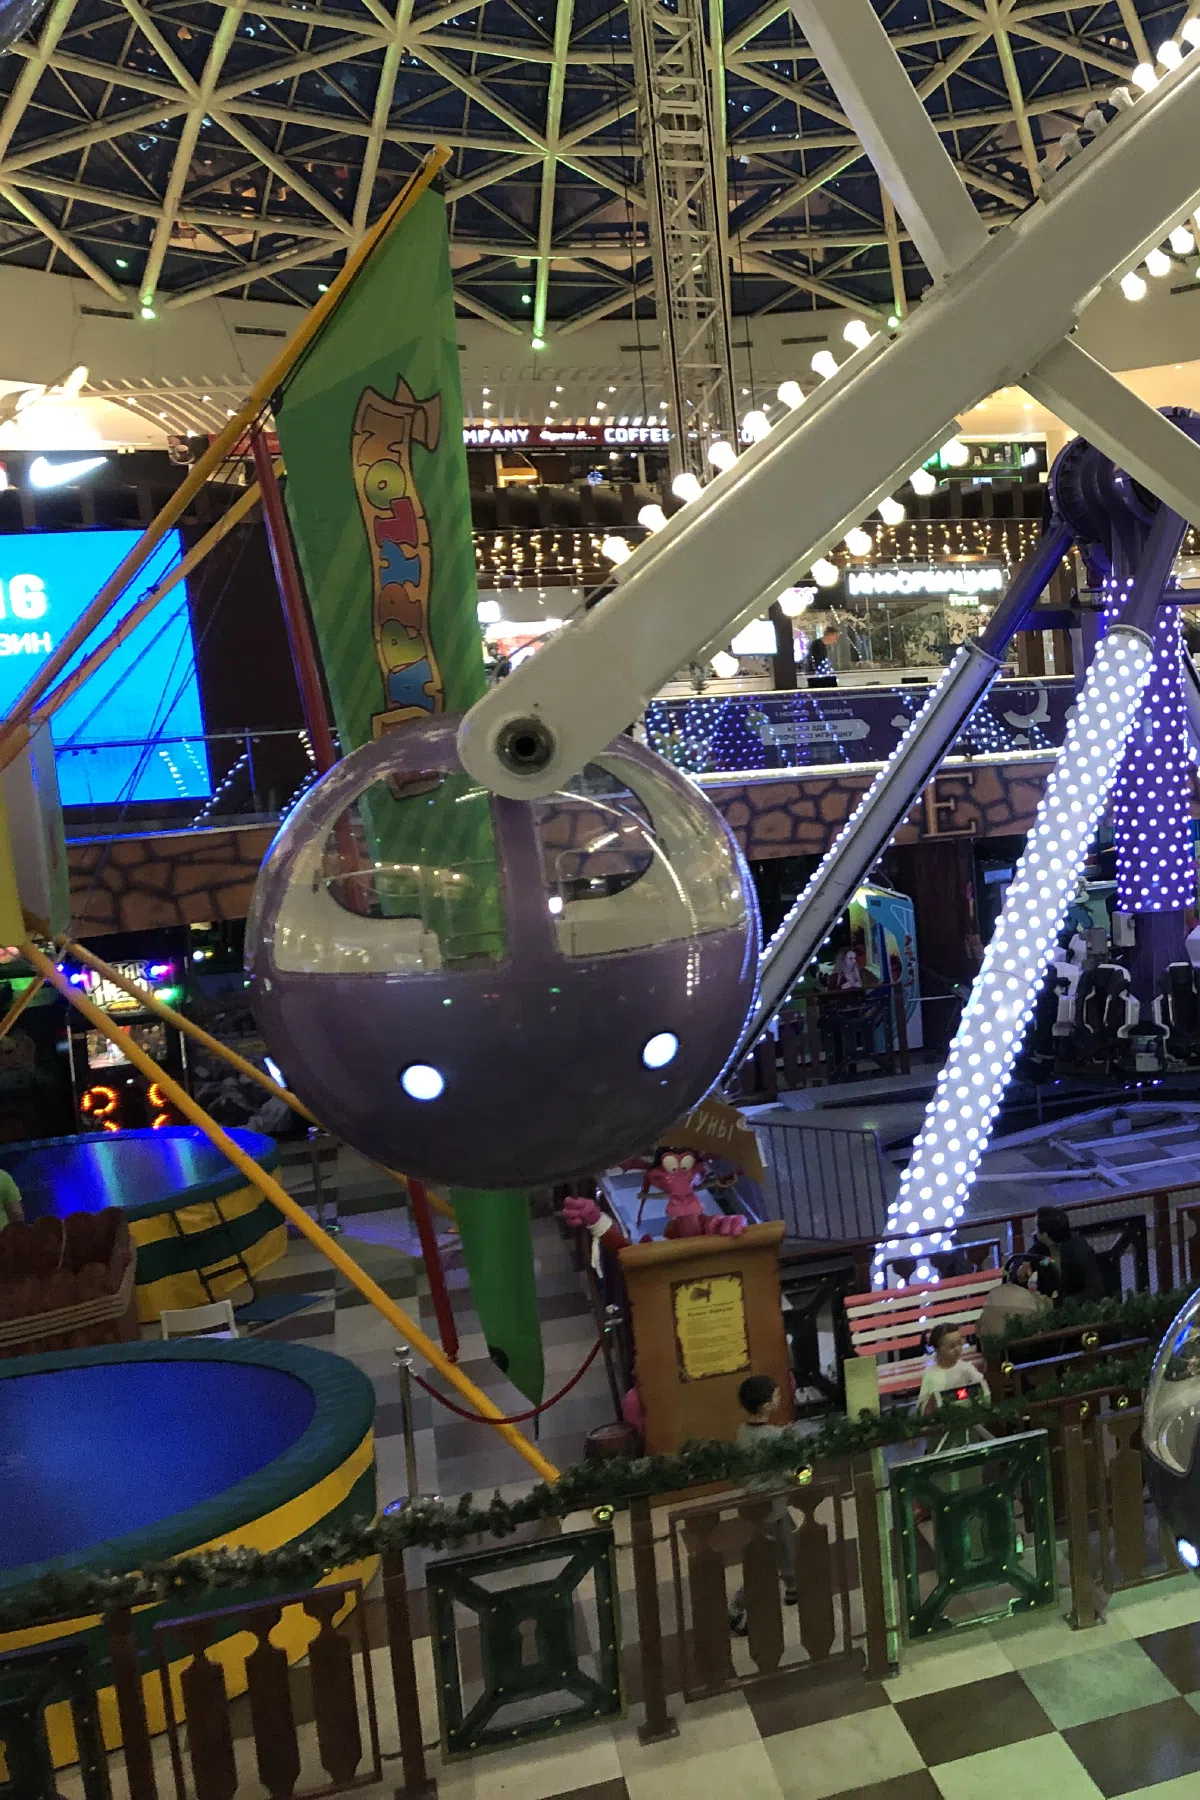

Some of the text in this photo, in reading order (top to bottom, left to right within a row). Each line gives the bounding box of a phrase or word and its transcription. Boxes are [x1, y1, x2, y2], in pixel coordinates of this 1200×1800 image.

[604, 428, 672, 443] COFFEE
[358, 403, 434, 728] APPYLON
[848, 569, 1002, 595] ИНФОРМАЦИЯ
